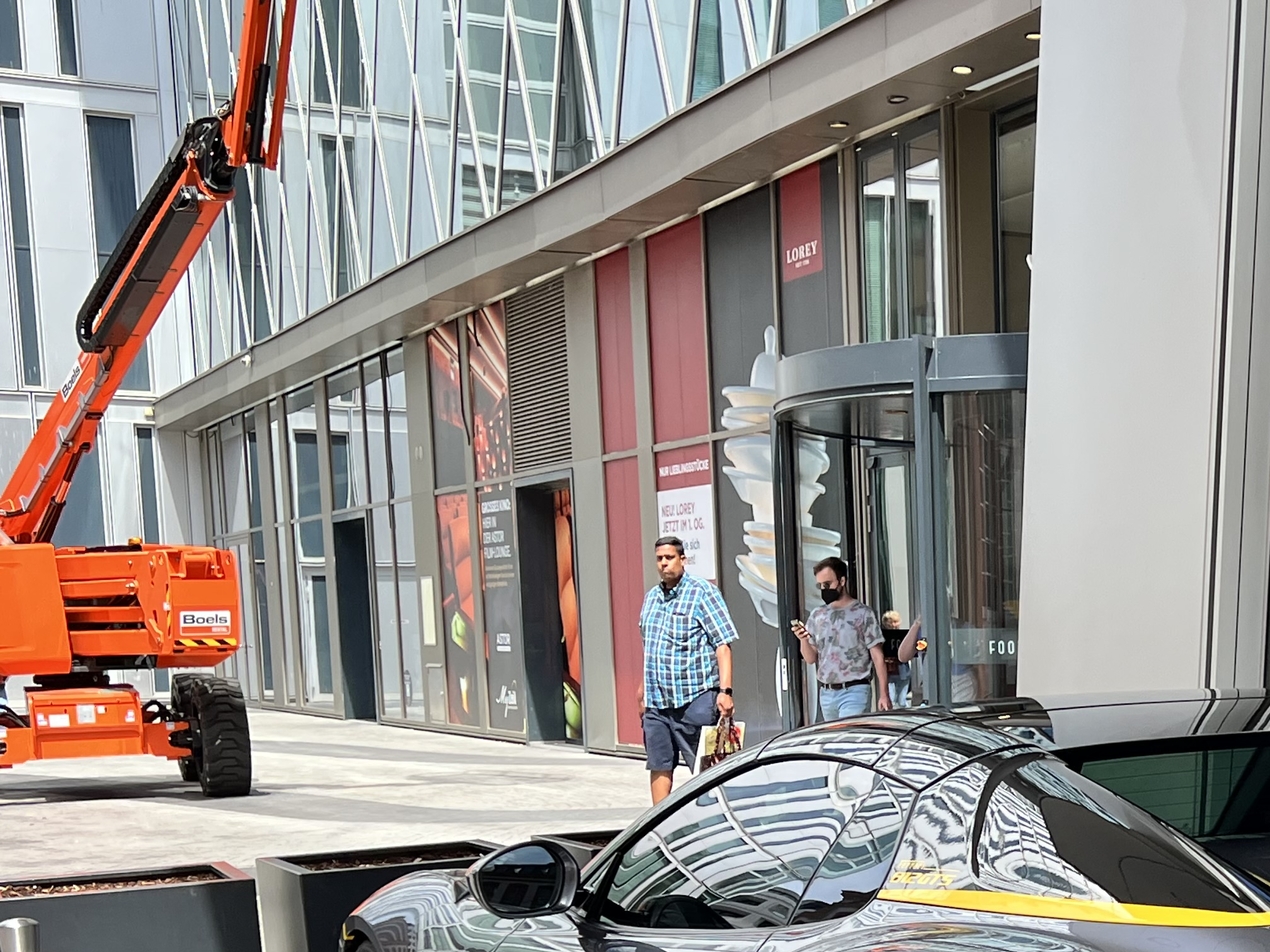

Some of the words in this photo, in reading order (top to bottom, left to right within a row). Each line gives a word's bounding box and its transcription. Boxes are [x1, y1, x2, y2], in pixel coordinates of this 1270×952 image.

[786, 240, 818, 264] LOREY
[61, 366, 81, 398] Boels
[661, 504, 675, 518] NEU!
[676, 502, 695, 516] LOREY
[662, 519, 679, 533] JETZT
[680, 519, 687, 531] IM
[183, 614, 228, 624] Boels
